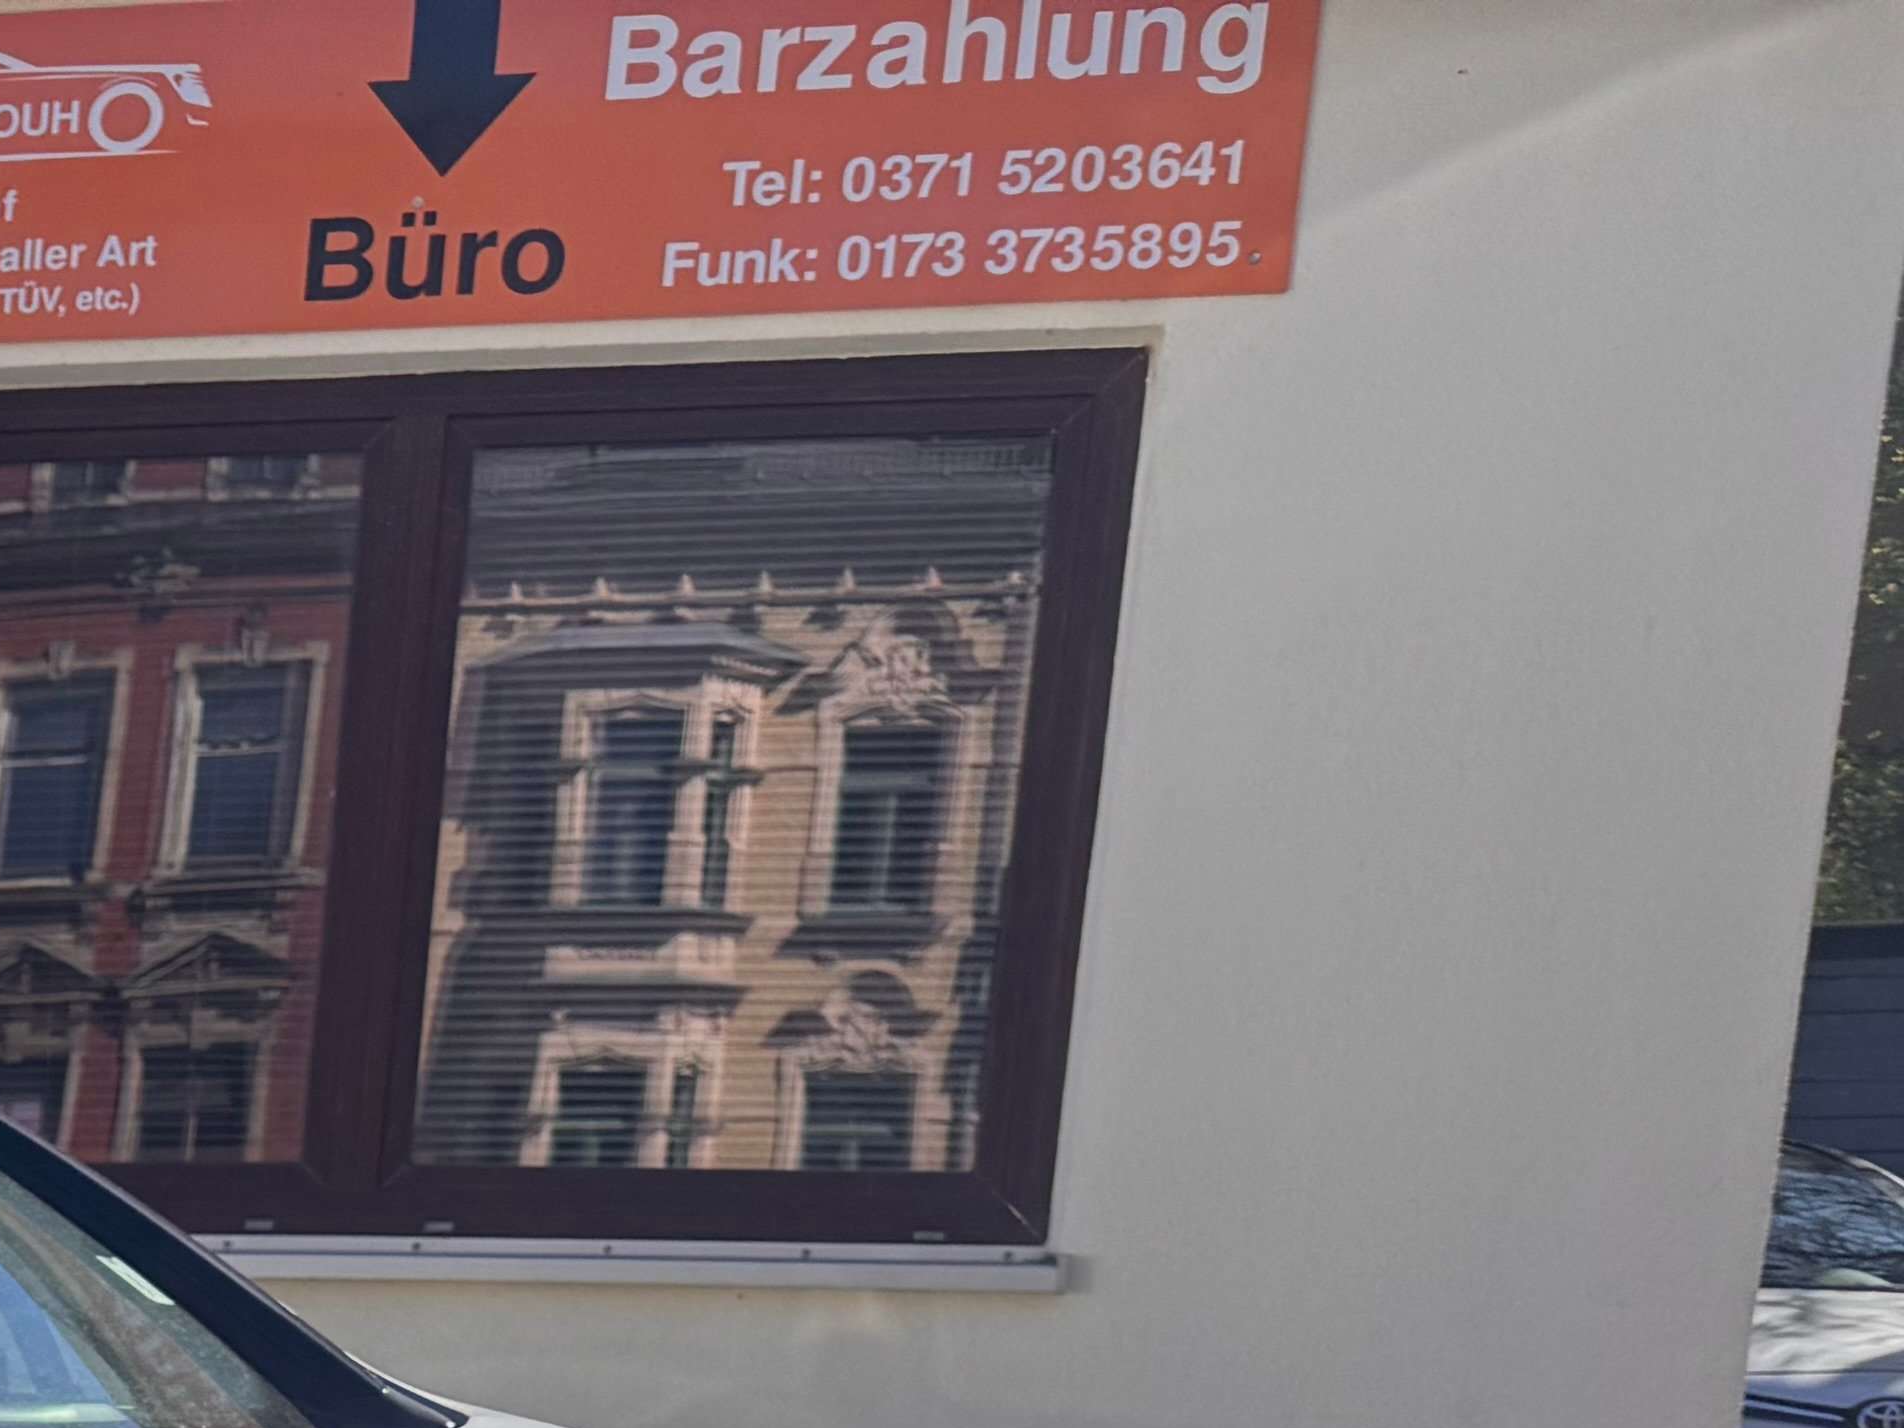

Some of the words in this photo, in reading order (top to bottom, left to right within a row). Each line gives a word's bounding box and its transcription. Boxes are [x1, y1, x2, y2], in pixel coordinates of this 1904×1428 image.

[605, 0, 1272, 101] Barzahlung
[723, 159, 823, 207] Tel:
[841, 151, 973, 203] 0371
[997, 139, 1246, 196] 5203641
[96, 235, 158, 267] Art
[303, 211, 566, 302] Büro
[661, 241, 819, 288] Funk:
[835, 233, 965, 283] 0173
[985, 221, 1244, 276] 3735895
[74, 284, 140, 315] etc.)
